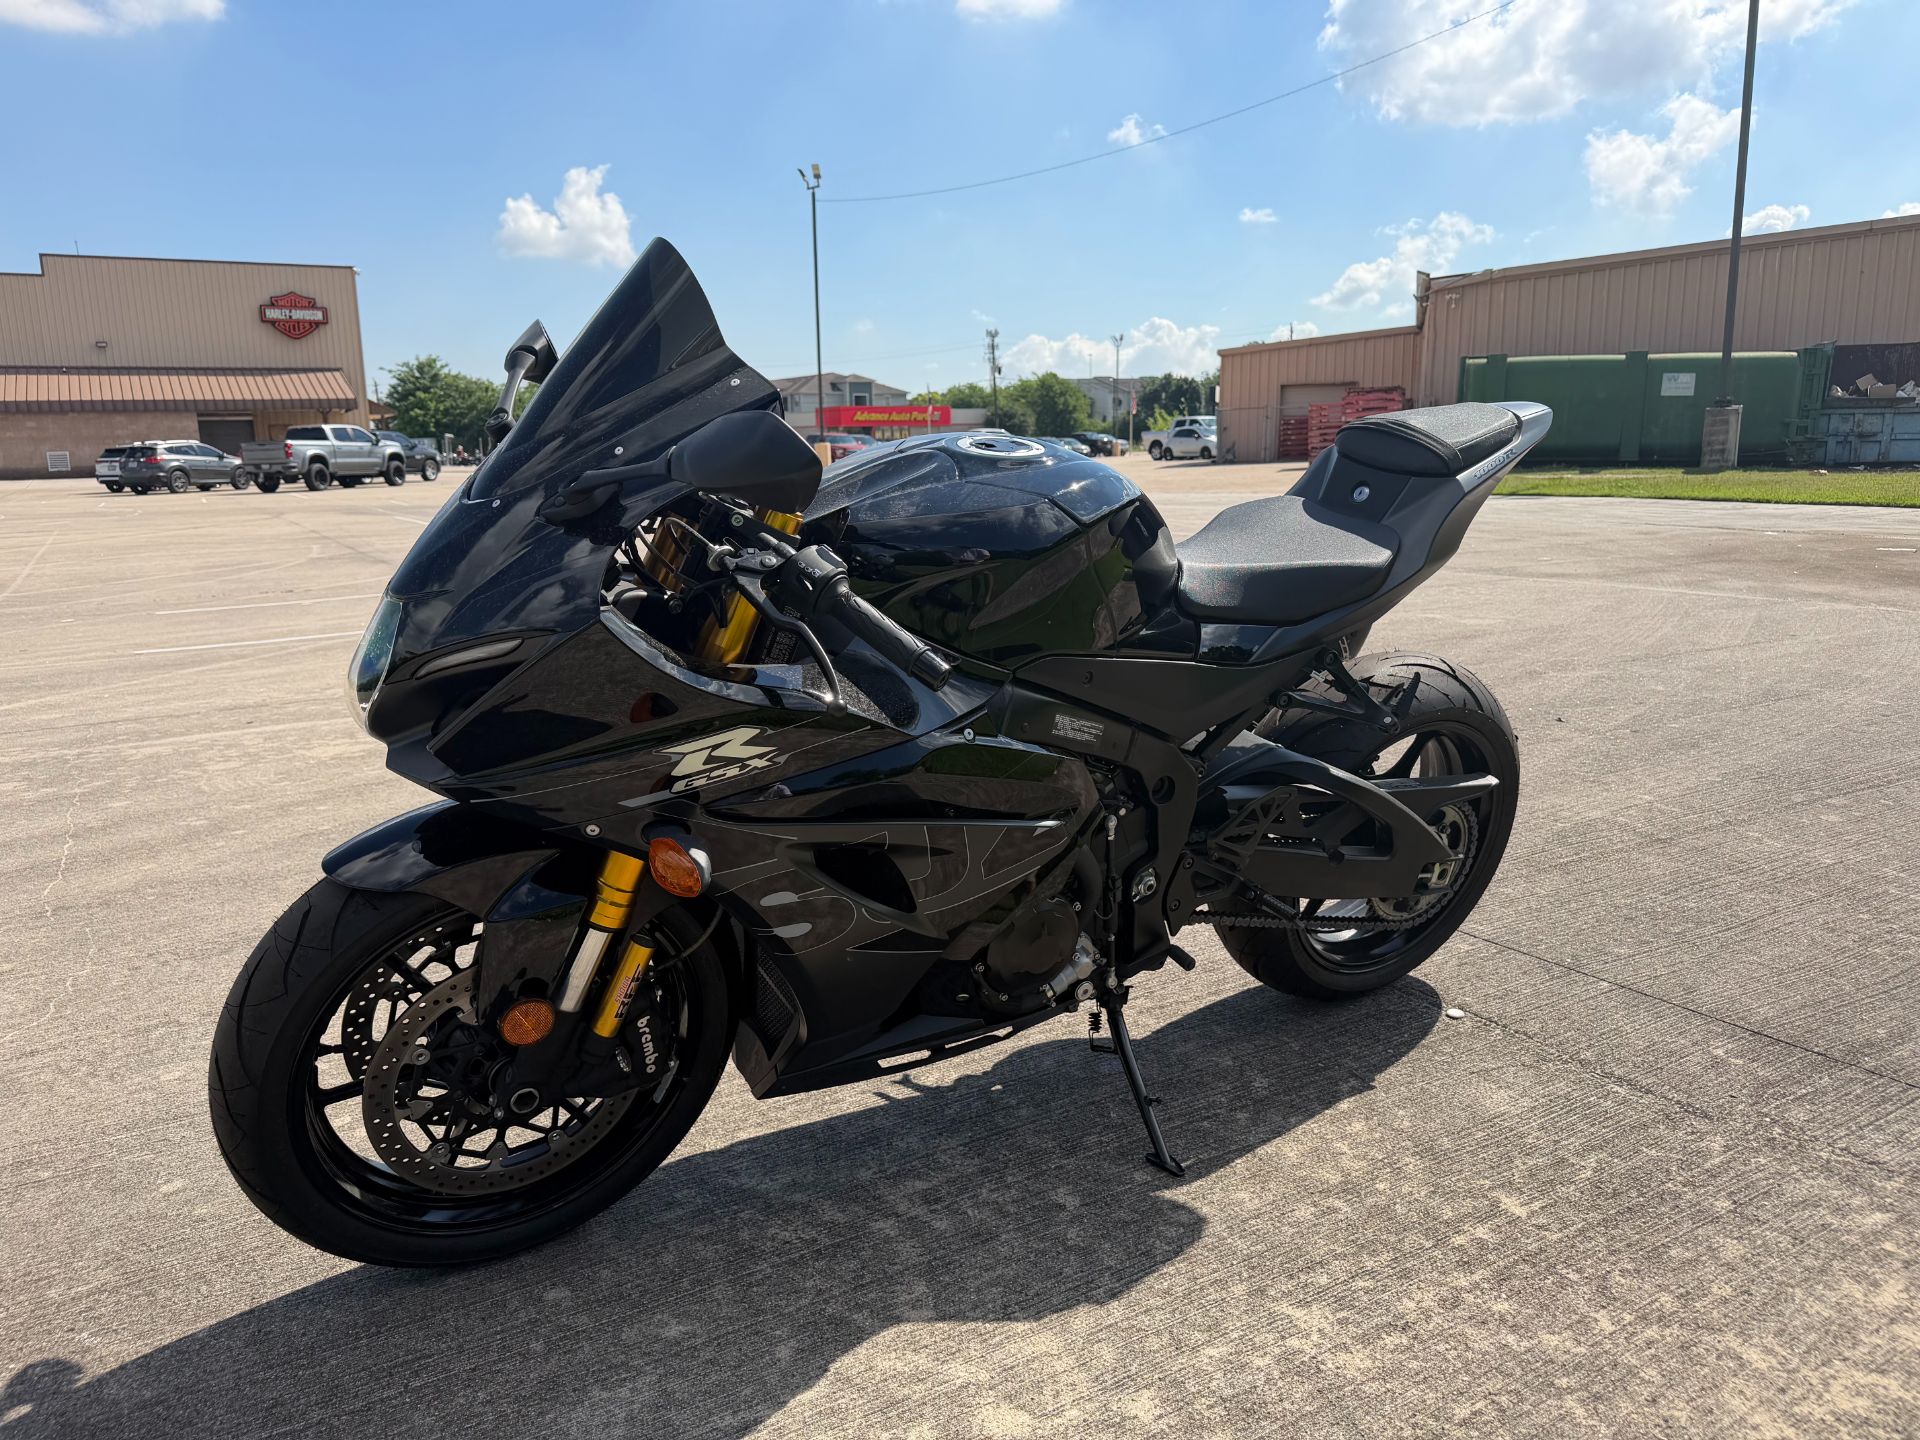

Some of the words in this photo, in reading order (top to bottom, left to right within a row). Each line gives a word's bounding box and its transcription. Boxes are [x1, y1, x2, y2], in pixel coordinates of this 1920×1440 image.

[265, 308, 323, 320] HARLEY-DAVIDSON
[280, 322, 312, 334] CYCLES
[853, 411, 889, 422] Advance
[889, 412, 911, 422] Auto
[670, 752, 779, 793] GSX
[614, 976, 631, 1003] SHOWA
[637, 1015, 659, 1074] brembo
